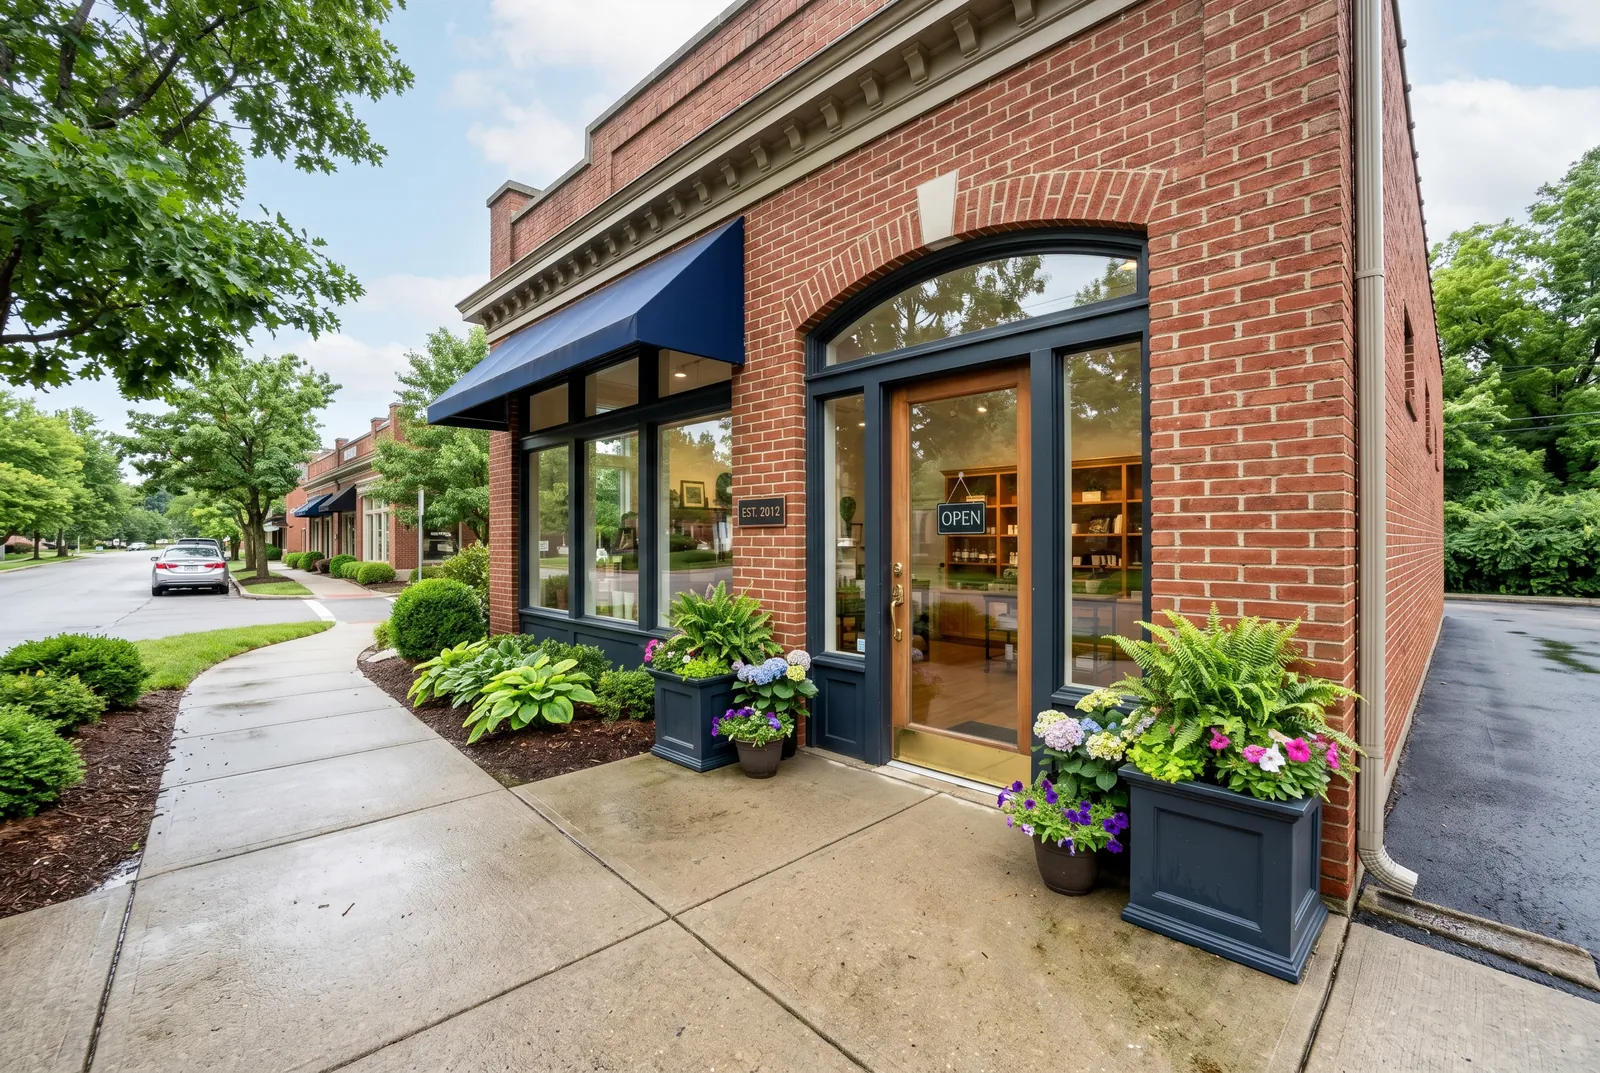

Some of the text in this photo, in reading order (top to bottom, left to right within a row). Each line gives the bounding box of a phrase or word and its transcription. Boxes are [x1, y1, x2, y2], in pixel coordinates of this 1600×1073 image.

[742, 506, 780, 518] EST. 2012
[941, 510, 981, 526] OPEN
